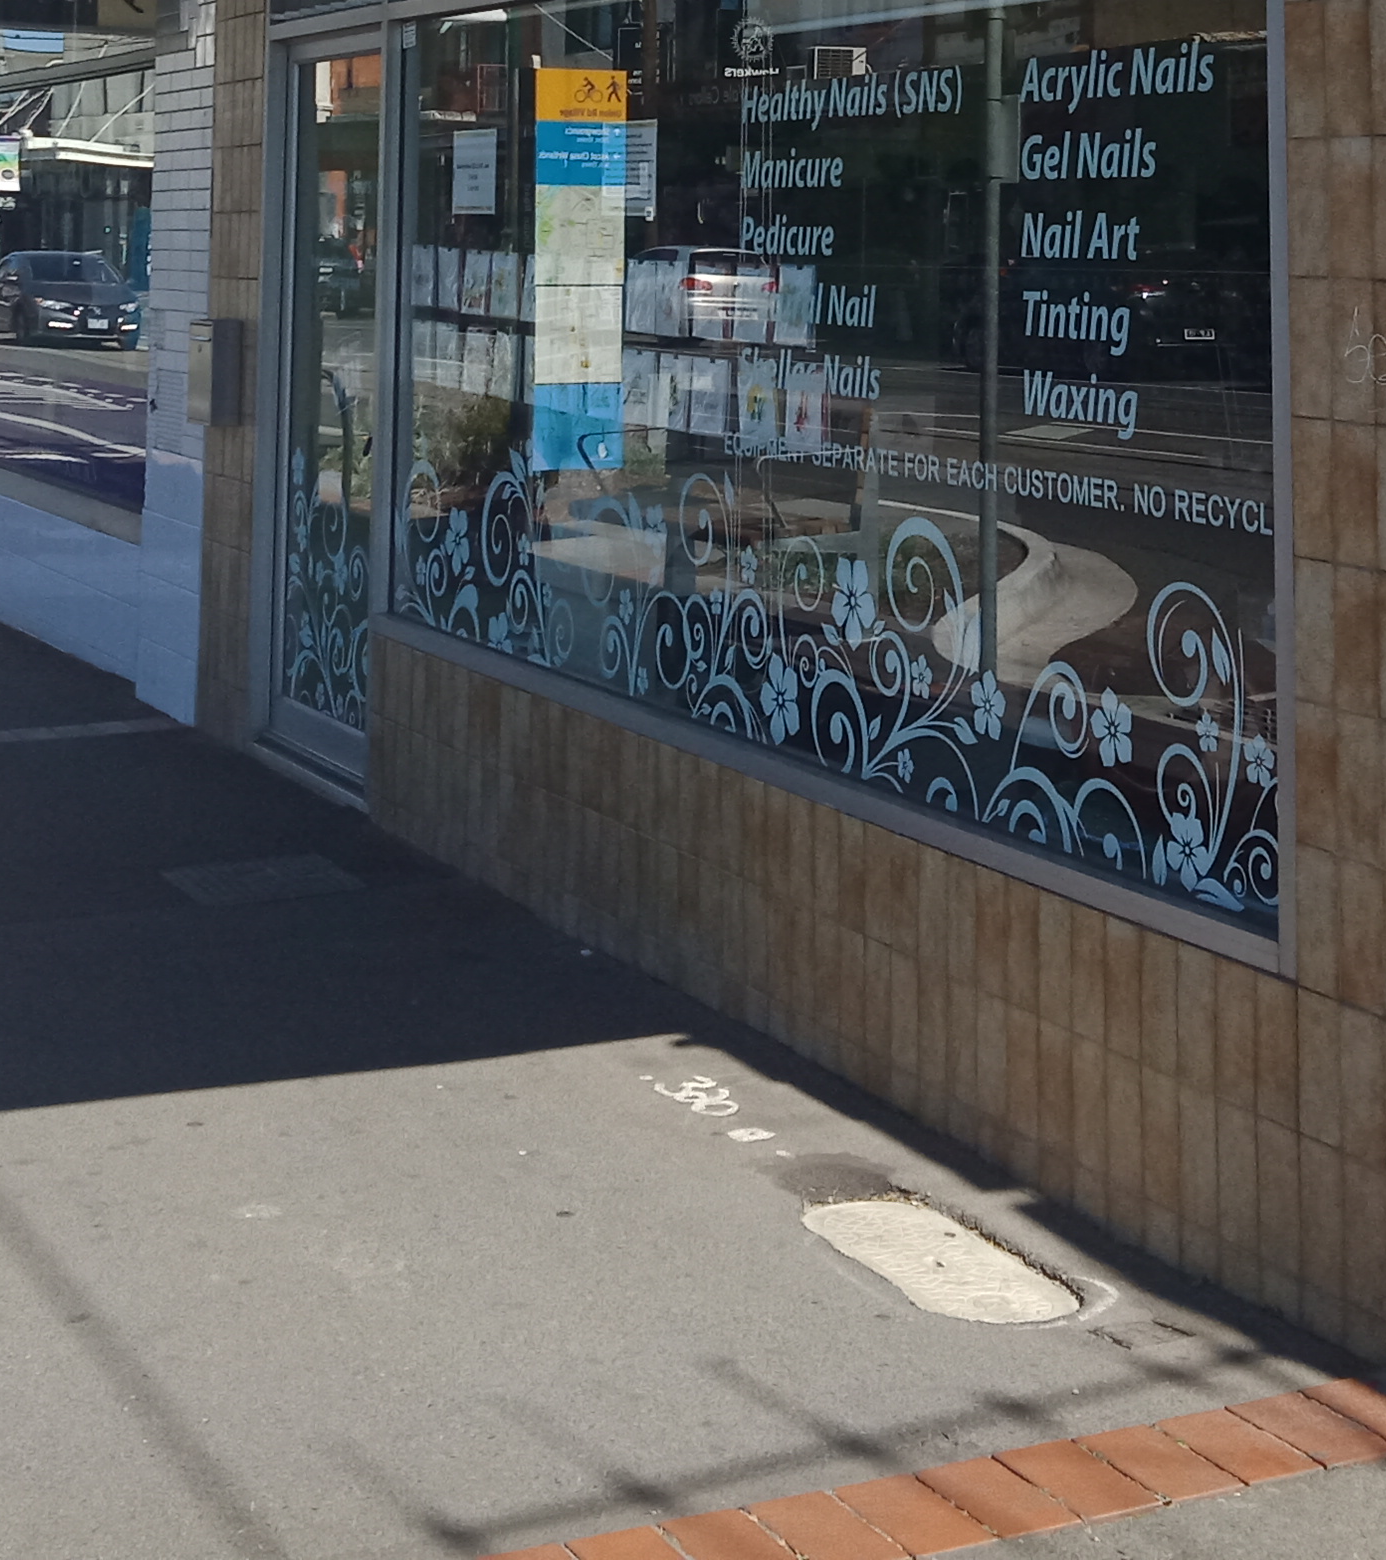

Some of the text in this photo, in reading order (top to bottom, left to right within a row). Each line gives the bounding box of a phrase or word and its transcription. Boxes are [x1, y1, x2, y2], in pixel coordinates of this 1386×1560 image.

[742, 65, 963, 131] Healthy Nails (SNS)
[1019, 40, 1215, 114] Acrylic Nails
[742, 147, 844, 189] Manicure
[1021, 127, 1157, 180] Gel Nails
[742, 214, 835, 256] Pedicure
[1021, 209, 1140, 261] Nail Art
[827, 284, 877, 328] Nail
[1022, 289, 1131, 357] Tinting
[824, 353, 882, 400] Nails
[1023, 368, 1138, 440] Waxing
[904, 452, 940, 483] FOR
[946, 457, 997, 492] EACH
[1004, 465, 1125, 511] CUSTOMER.
[1134, 483, 1166, 518] NO
[1174, 488, 1273, 536] RECYCL
